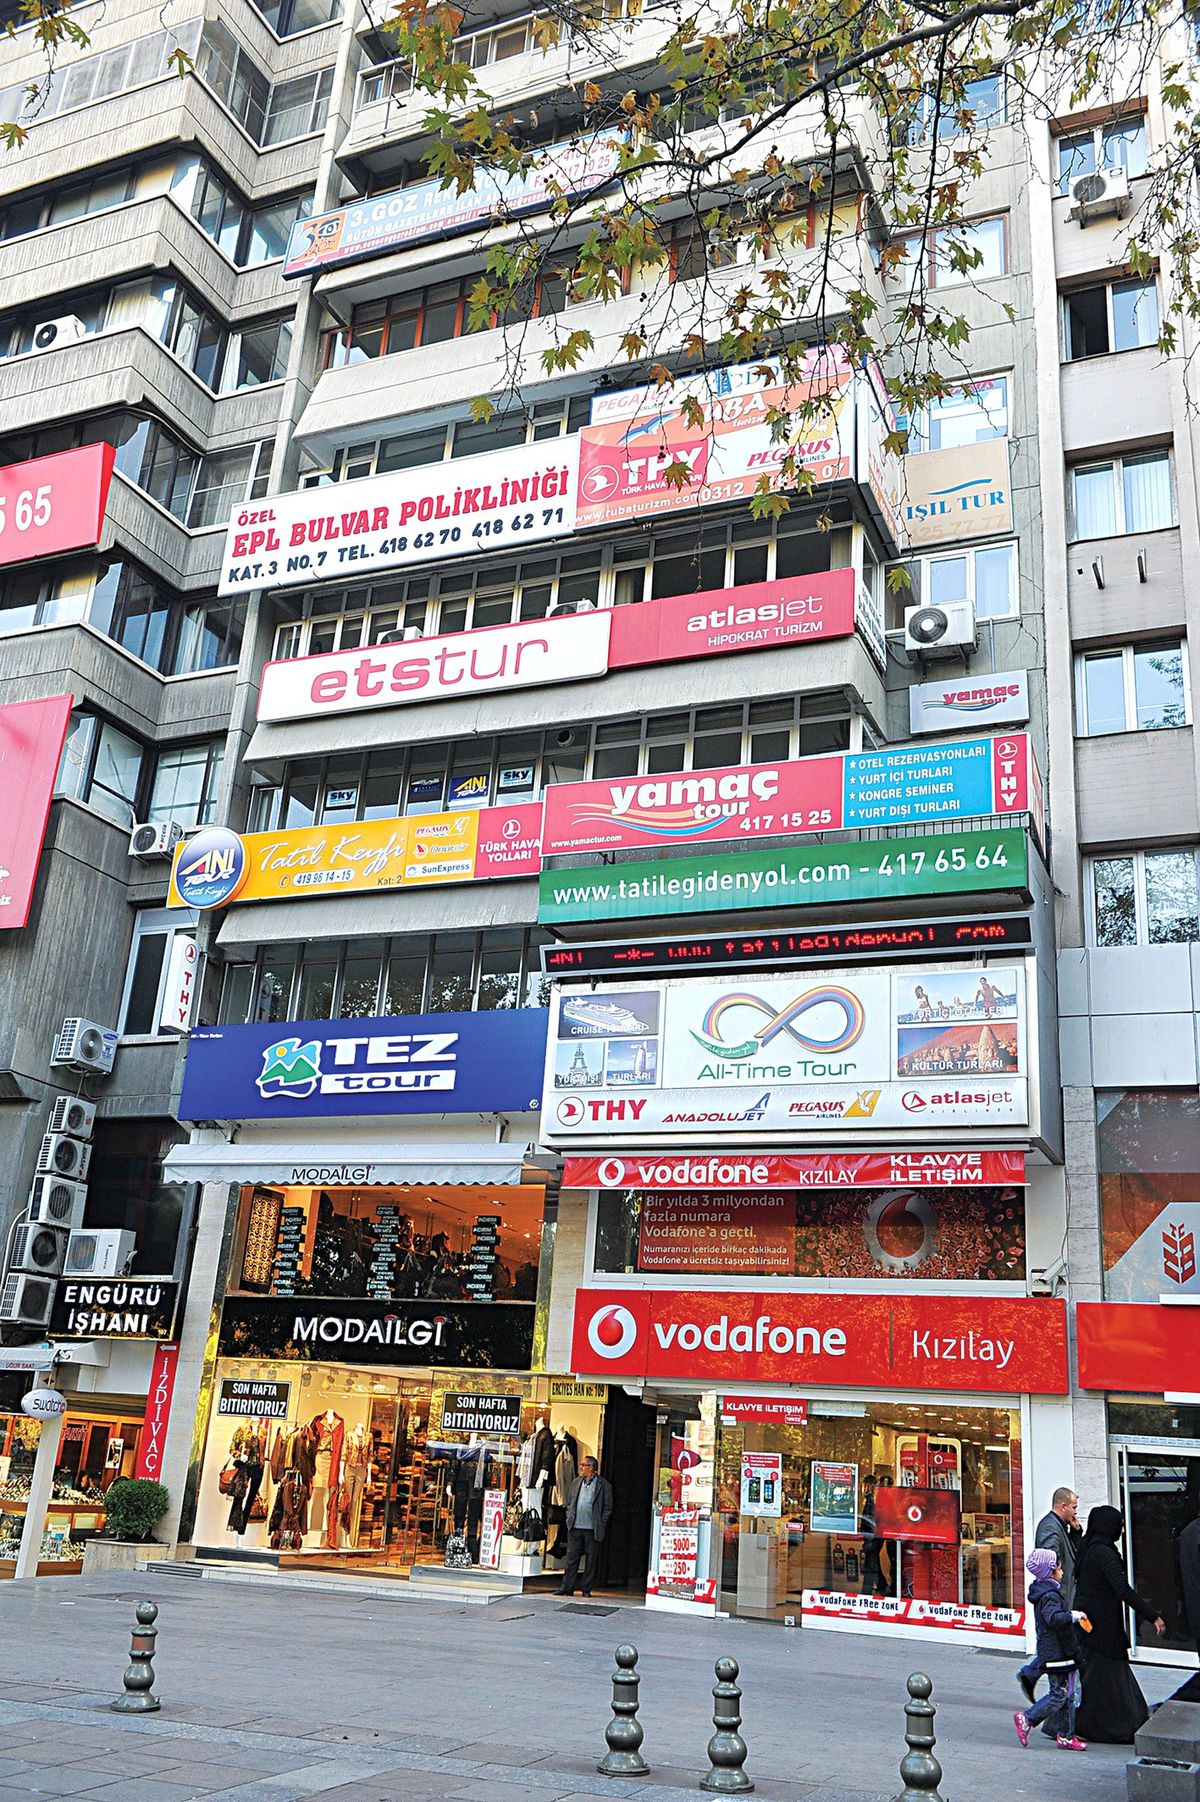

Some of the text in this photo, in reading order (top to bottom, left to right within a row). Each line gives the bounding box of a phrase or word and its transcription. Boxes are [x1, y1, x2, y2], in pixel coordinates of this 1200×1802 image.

[598, 154, 612, 170] 25
[621, 484, 642, 496] TÜRK
[644, 480, 667, 492] HAVA
[700, 481, 745, 502] 0312
[15, 484, 52, 532] 65
[232, 464, 569, 558] EPL BULVAR POLİKLİNİĞİ
[906, 490, 1005, 523] IŞIL TUR
[237, 507, 277, 528] ÖZEL
[338, 543, 375, 563] TEL.
[379, 533, 408, 556] 418
[413, 529, 435, 550] 62
[439, 525, 462, 546] 70
[471, 518, 504, 540] 418
[510, 512, 534, 532] 62
[542, 506, 566, 526] 71
[686, 593, 824, 632] atlasjet
[707, 619, 824, 648] HİPOKRAT TURİZM
[310, 637, 549, 704] etstur
[943, 683, 1020, 705] yamaç
[859, 745, 986, 770] OTEL REZERVASYONLARI
[503, 769, 531, 781] sky
[859, 766, 953, 786] YURT İÇİ TURLARI
[1001, 760, 1018, 807] THY
[610, 769, 779, 816] yamaç
[859, 781, 954, 801] KONGRE SEMİNER
[694, 799, 750, 821] tour
[859, 799, 961, 819] YURT DIŞI TURLARI
[739, 809, 833, 832] 417 15 25
[479, 838, 540, 854] TÜRK HAVA
[551, 833, 623, 849] www.yamactur.com
[179, 847, 235, 875] ANI
[260, 832, 406, 877] Tatil Keyfi
[487, 850, 532, 864] YOLLARI
[325, 871, 335, 882] 14
[341, 869, 352, 881] 15
[422, 863, 470, 875] SunExpress
[553, 862, 851, 905] www.tatilegidenyol.com
[878, 851, 926, 878] 417
[934, 847, 967, 873] 65
[975, 844, 1008, 869] 64
[377, 875, 403, 886] Kat: 2
[179, 970, 192, 1023] THY
[571, 1025, 603, 1035] CRUISE
[325, 1032, 459, 1066] TEZ
[697, 1060, 857, 1080] All-Time Tour
[911, 1059, 1003, 1072] KÜLTÜR TURLARI
[335, 1072, 442, 1091] tour
[788, 1101, 846, 1113] PEGASUS
[930, 1090, 1013, 1107] atlasjet
[588, 1099, 647, 1121] THY
[662, 1112, 765, 1123] ANADOLUJET
[890, 1153, 982, 1167] KLAVYE
[639, 1158, 859, 1184] vodafone KIZILAY
[646, 1194, 785, 1209] Bir yılda 3 milyondan
[645, 1211, 731, 1222] fazla numara
[721, 1225, 757, 1241] geçti.
[643, 1244, 787, 1255] Numaranızı içeride birkaç dakikada
[689, 1256, 723, 1266] ücretsiz
[724, 1256, 790, 1267] taşıyabilirsiniz!
[64, 1284, 161, 1306] ENGÜRÜ
[67, 1308, 149, 1335] İŞHANI
[293, 1314, 447, 1346] MODAİLGİ
[654, 1315, 1015, 1370] vodafone Kızılay
[232, 1382, 277, 1396] SON HAFTA
[574, 1383, 585, 1397] HAN
[594, 1384, 605, 1398] 109
[457, 1397, 507, 1411] SON HAFTA
[726, 1402, 763, 1412] KLAVYE
[145, 1357, 169, 1472] İZDİVAÇ
[673, 1538, 690, 1552] 5000
